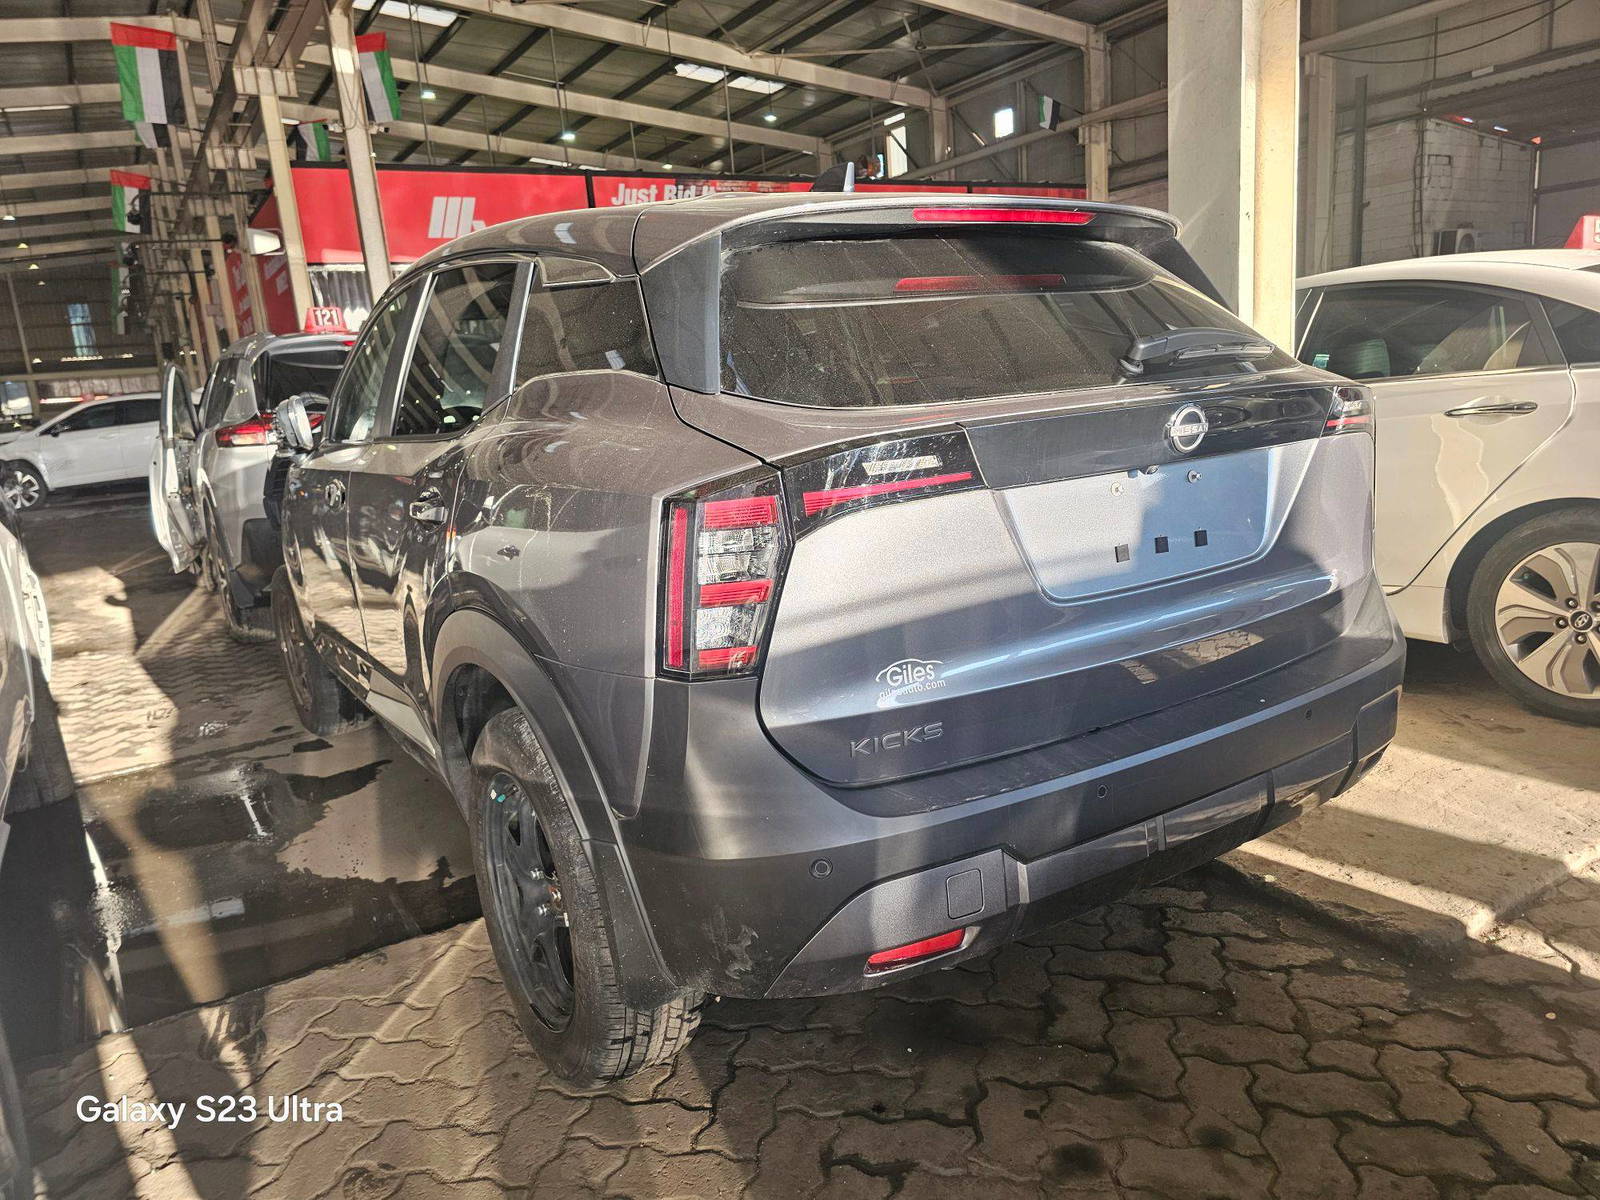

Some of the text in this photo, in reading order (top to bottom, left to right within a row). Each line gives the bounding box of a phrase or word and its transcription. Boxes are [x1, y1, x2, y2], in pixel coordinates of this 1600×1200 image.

[611, 183, 658, 206] Just
[663, 184, 697, 200] Bid
[314, 308, 340, 327] 121
[1170, 423, 1208, 437] NISSAN
[886, 664, 935, 687] Giles
[850, 721, 943, 759] KICKS
